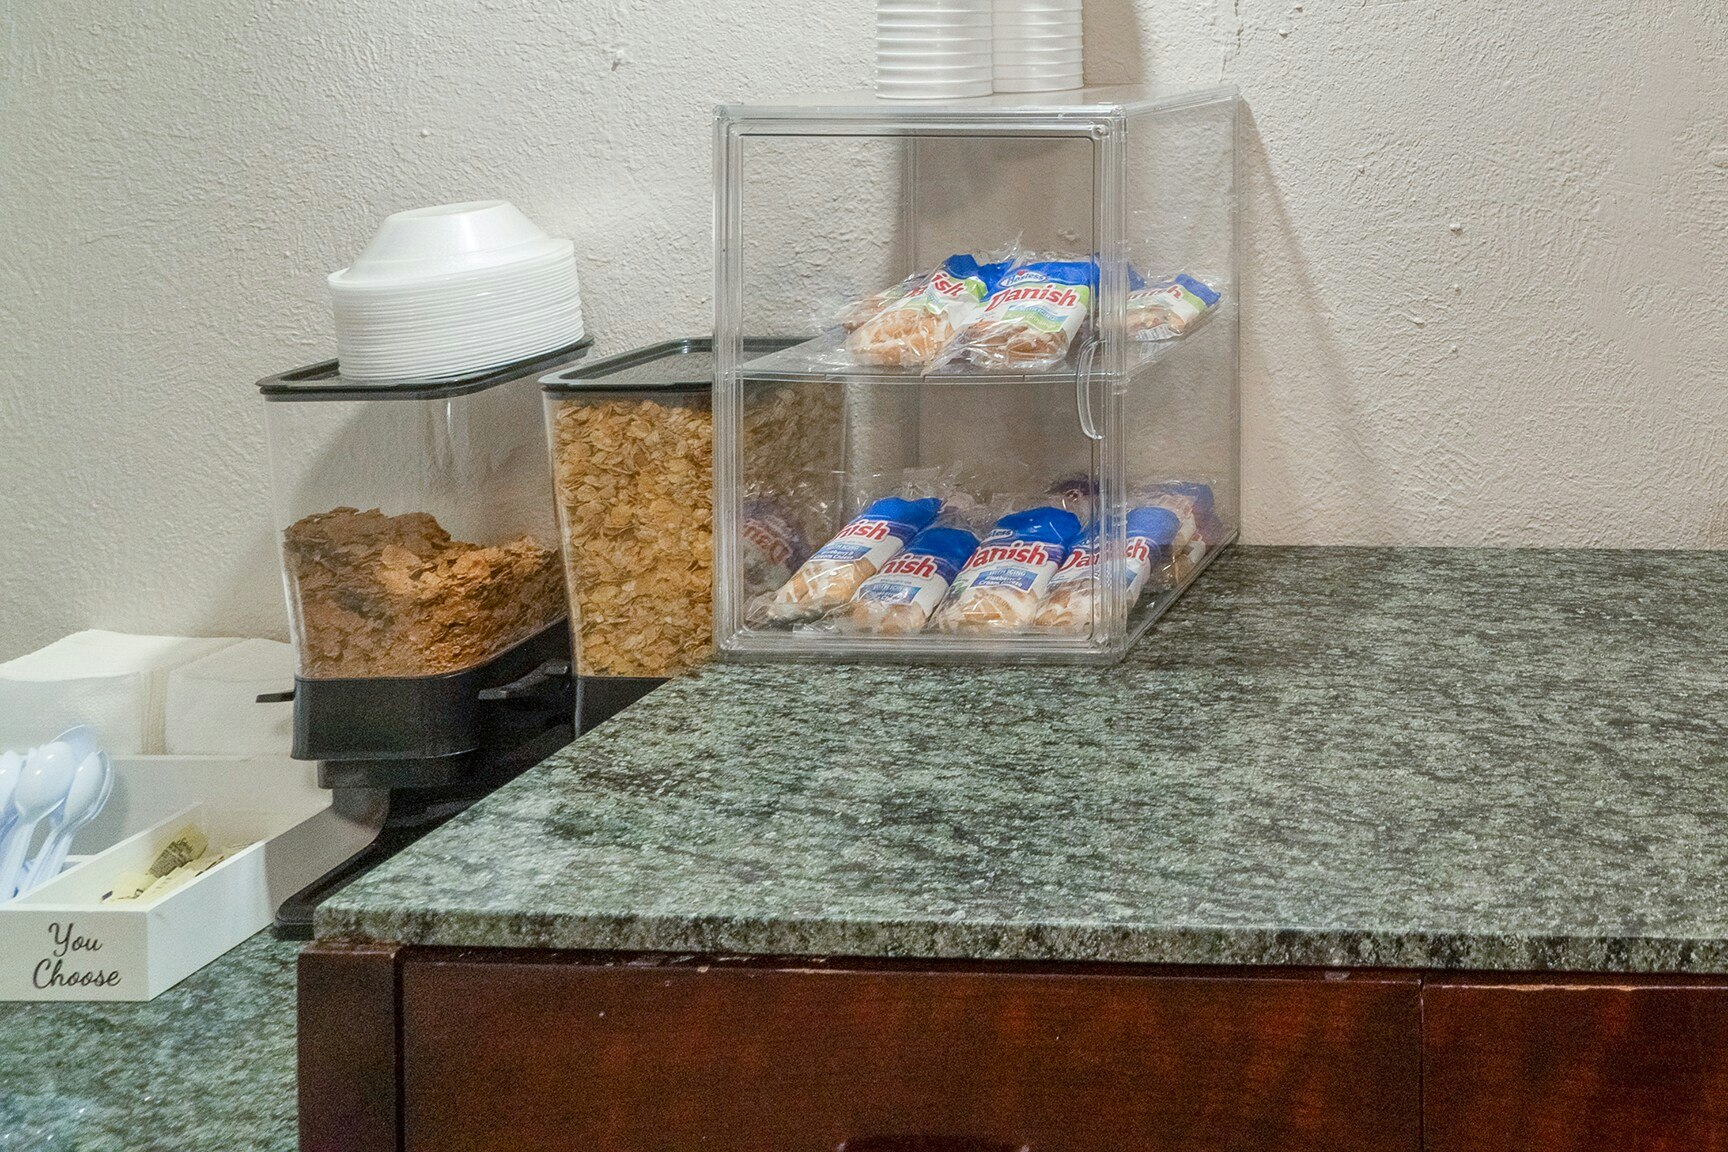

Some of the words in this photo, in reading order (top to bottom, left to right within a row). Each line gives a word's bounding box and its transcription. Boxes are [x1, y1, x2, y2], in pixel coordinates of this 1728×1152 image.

[984, 284, 1078, 313] Danish
[48, 921, 104, 957] You
[32, 957, 122, 990] Choose
